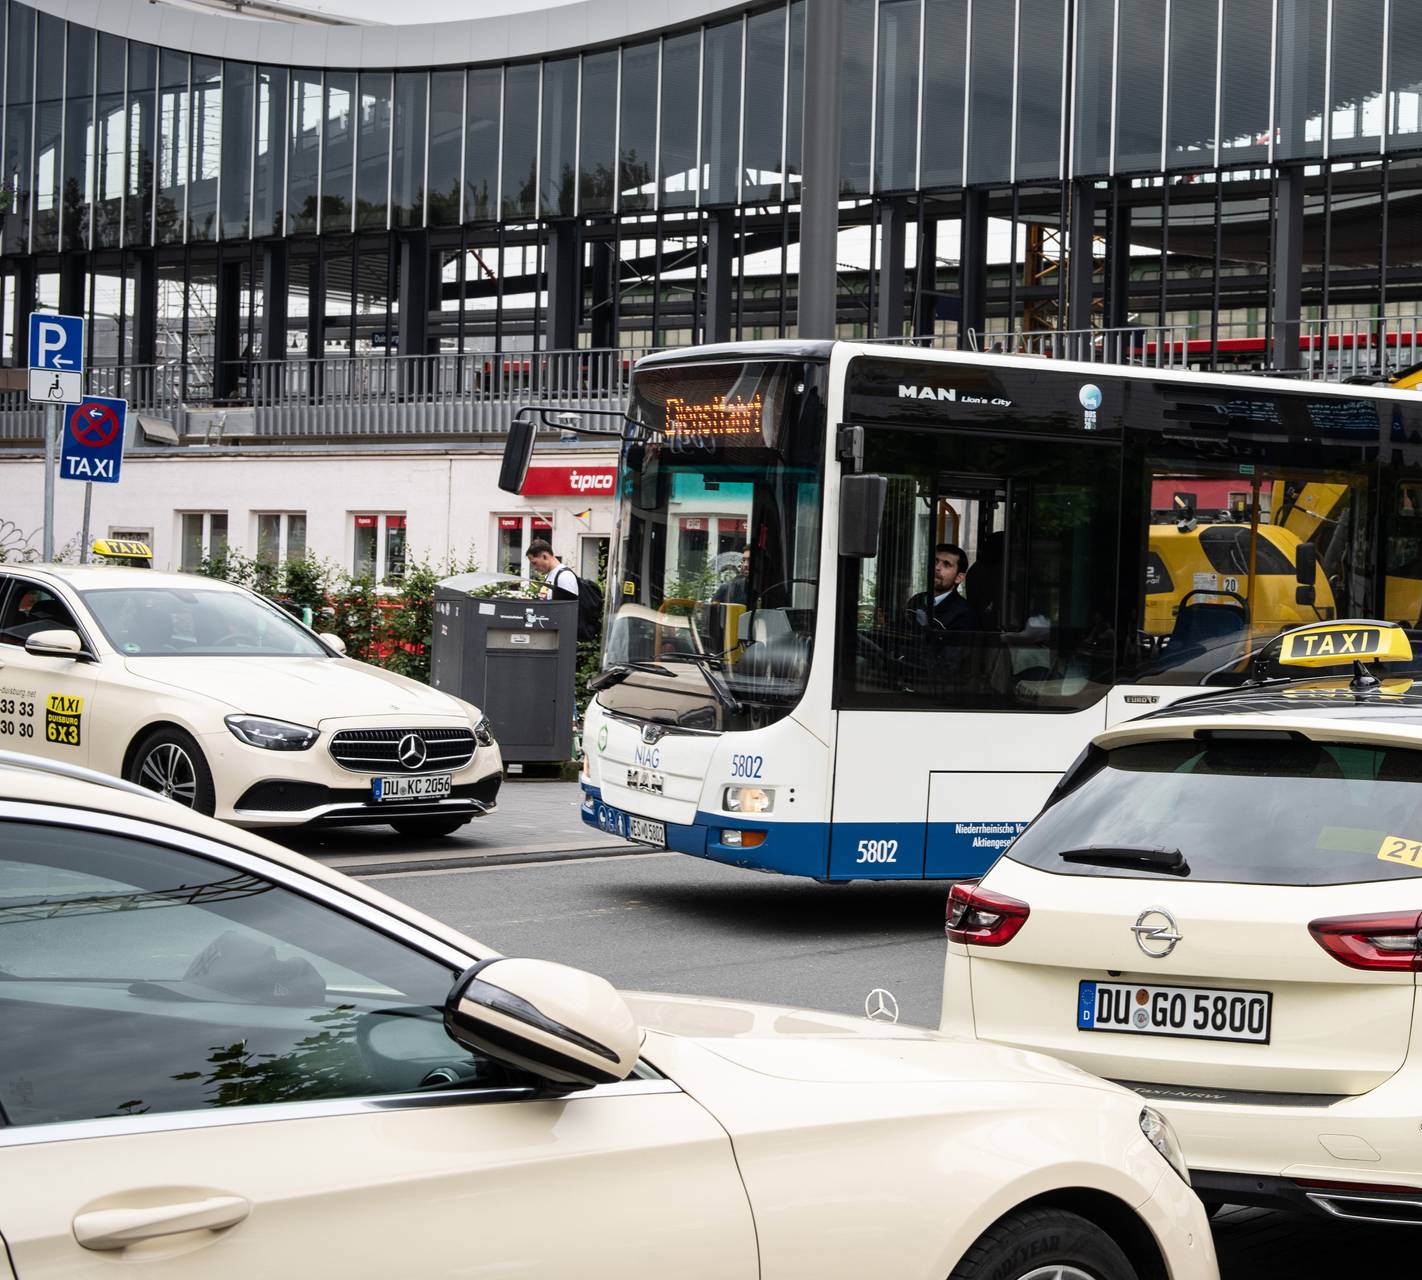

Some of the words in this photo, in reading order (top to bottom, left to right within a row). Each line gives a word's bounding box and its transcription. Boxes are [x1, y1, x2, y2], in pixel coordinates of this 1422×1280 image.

[38, 322, 67, 367] P
[899, 385, 956, 402] MAN
[961, 396, 988, 404] Lion's
[991, 398, 1012, 407] City
[66, 456, 114, 478] TAXI
[569, 470, 613, 492] tipico
[107, 542, 146, 554] TAXI
[1225, 579, 1236, 592] 20
[1303, 632, 1369, 656] TAXI
[0, 699, 15, 714] 33
[19, 702, 34, 717] 33
[51, 696, 80, 712] TAXI
[0, 720, 15, 735] 30
[19, 723, 34, 738] 30
[48, 714, 78, 725] DUISBURG
[635, 746, 660, 768] NIAG
[731, 754, 764, 779] 5802
[383, 780, 399, 795] DU
[408, 780, 422, 794] KC
[425, 777, 450, 793] 2056
[649, 824, 664, 843] 5802
[955, 823, 1014, 835] Niederrheinische
[856, 840, 898, 863] 5802
[1083, 1010, 1090, 1020] D
[1096, 988, 1132, 1024] DU
[1151, 992, 1186, 1028] GO
[1193, 994, 1265, 1033] 5800
